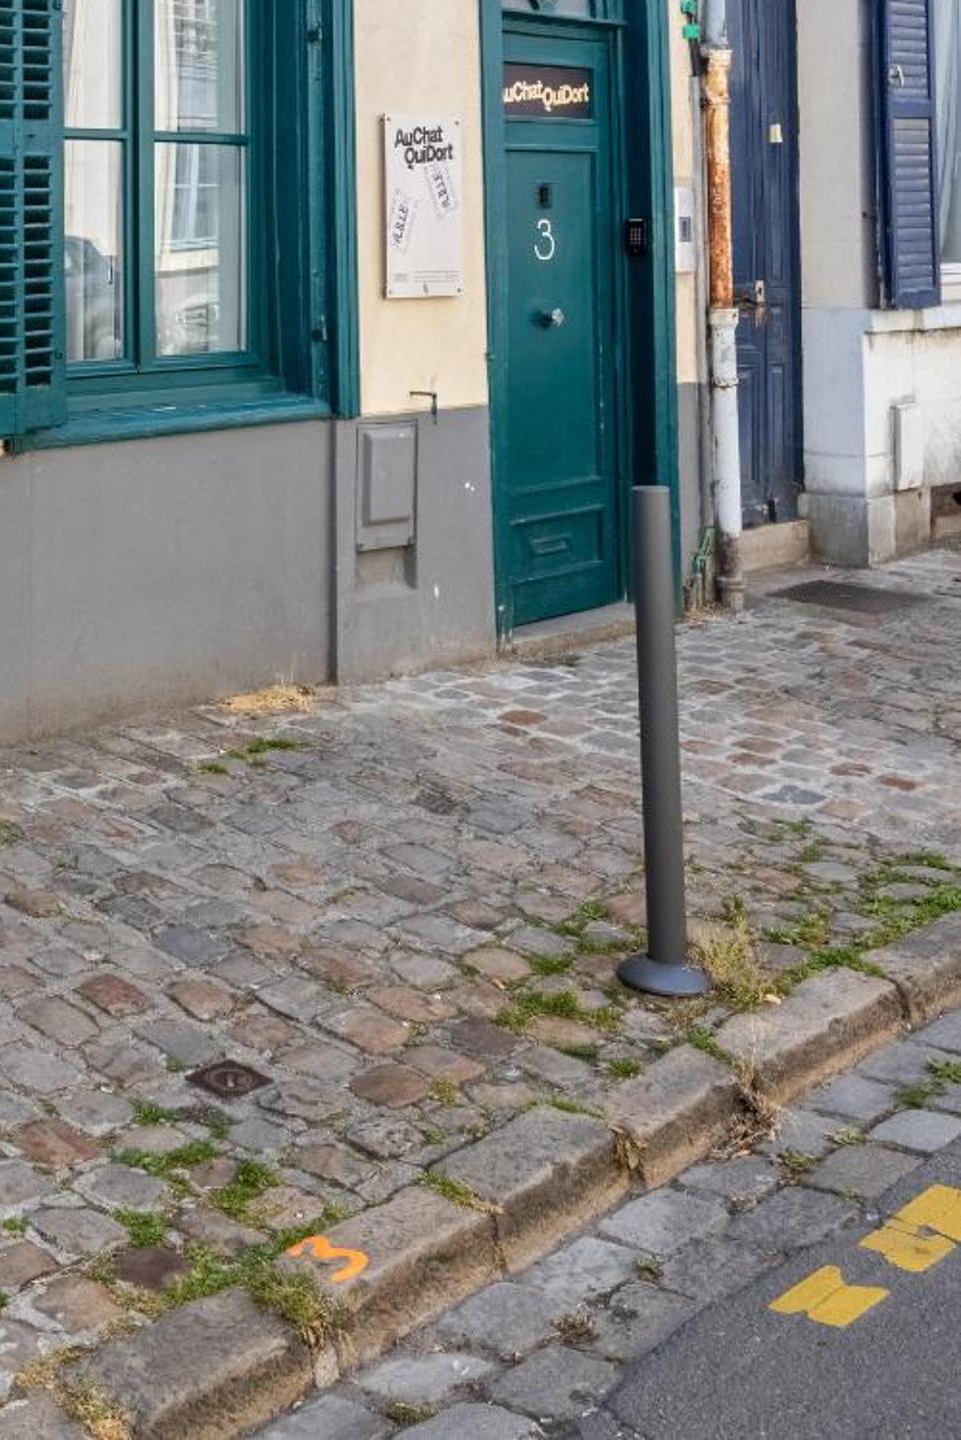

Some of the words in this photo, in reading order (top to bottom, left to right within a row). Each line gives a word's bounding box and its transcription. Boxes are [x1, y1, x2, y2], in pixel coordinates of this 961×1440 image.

[503, 79, 543, 103] uChat
[542, 82, 589, 112] QuiDort
[394, 125, 444, 148] AuChat
[404, 143, 454, 170] QuiDort
[533, 218, 556, 260] 3
